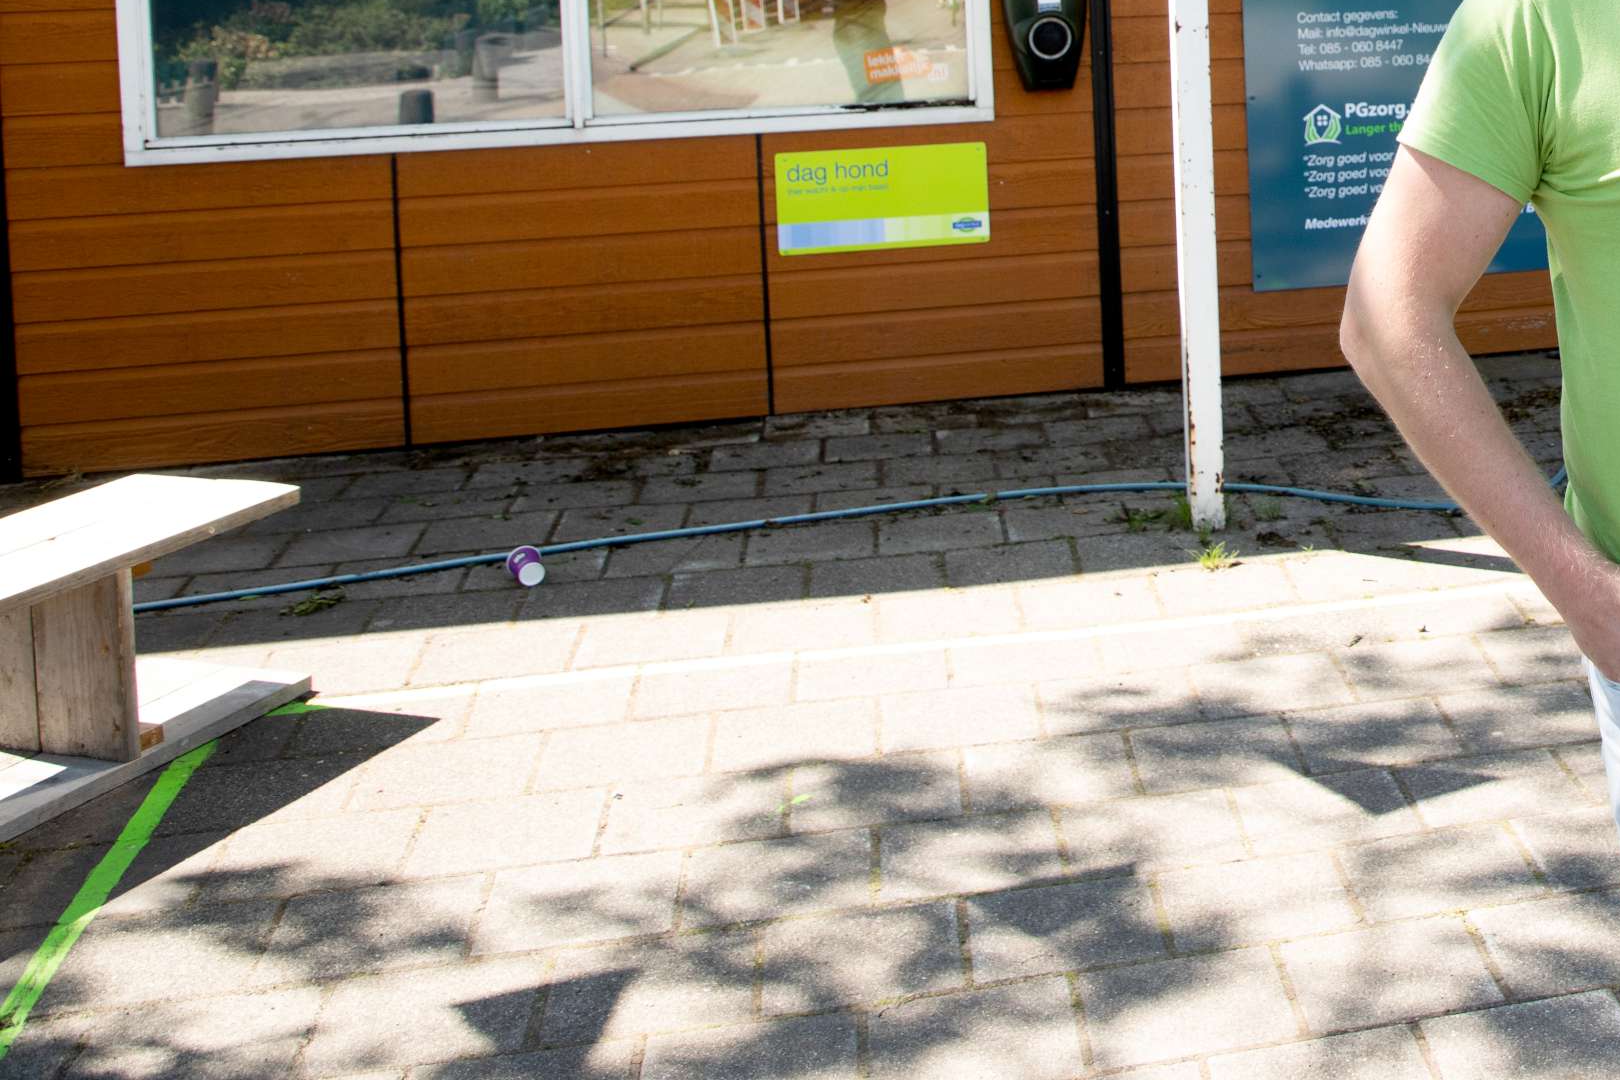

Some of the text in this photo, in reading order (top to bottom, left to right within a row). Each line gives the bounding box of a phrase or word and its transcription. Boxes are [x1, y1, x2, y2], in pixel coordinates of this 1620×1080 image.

[1297, 10, 1398, 24] Contact gegevens:
[1326, 22, 1449, 39] info@dagwinkel-Nieuw
[1319, 43, 1341, 54] 085
[1352, 41, 1373, 52] 060
[1376, 39, 1403, 52] 8447
[1360, 56, 1382, 68] 085
[1392, 55, 1413, 66] 060
[1416, 54, 1431, 65] 84
[1345, 102, 1413, 119] PGzorg.
[1345, 121, 1402, 136] Langer th
[1337, 152, 1367, 166] goed
[787, 160, 888, 184] dag hond
[1337, 168, 1367, 182] goed
[1369, 167, 1389, 178] voo
[1338, 184, 1367, 198] goed
